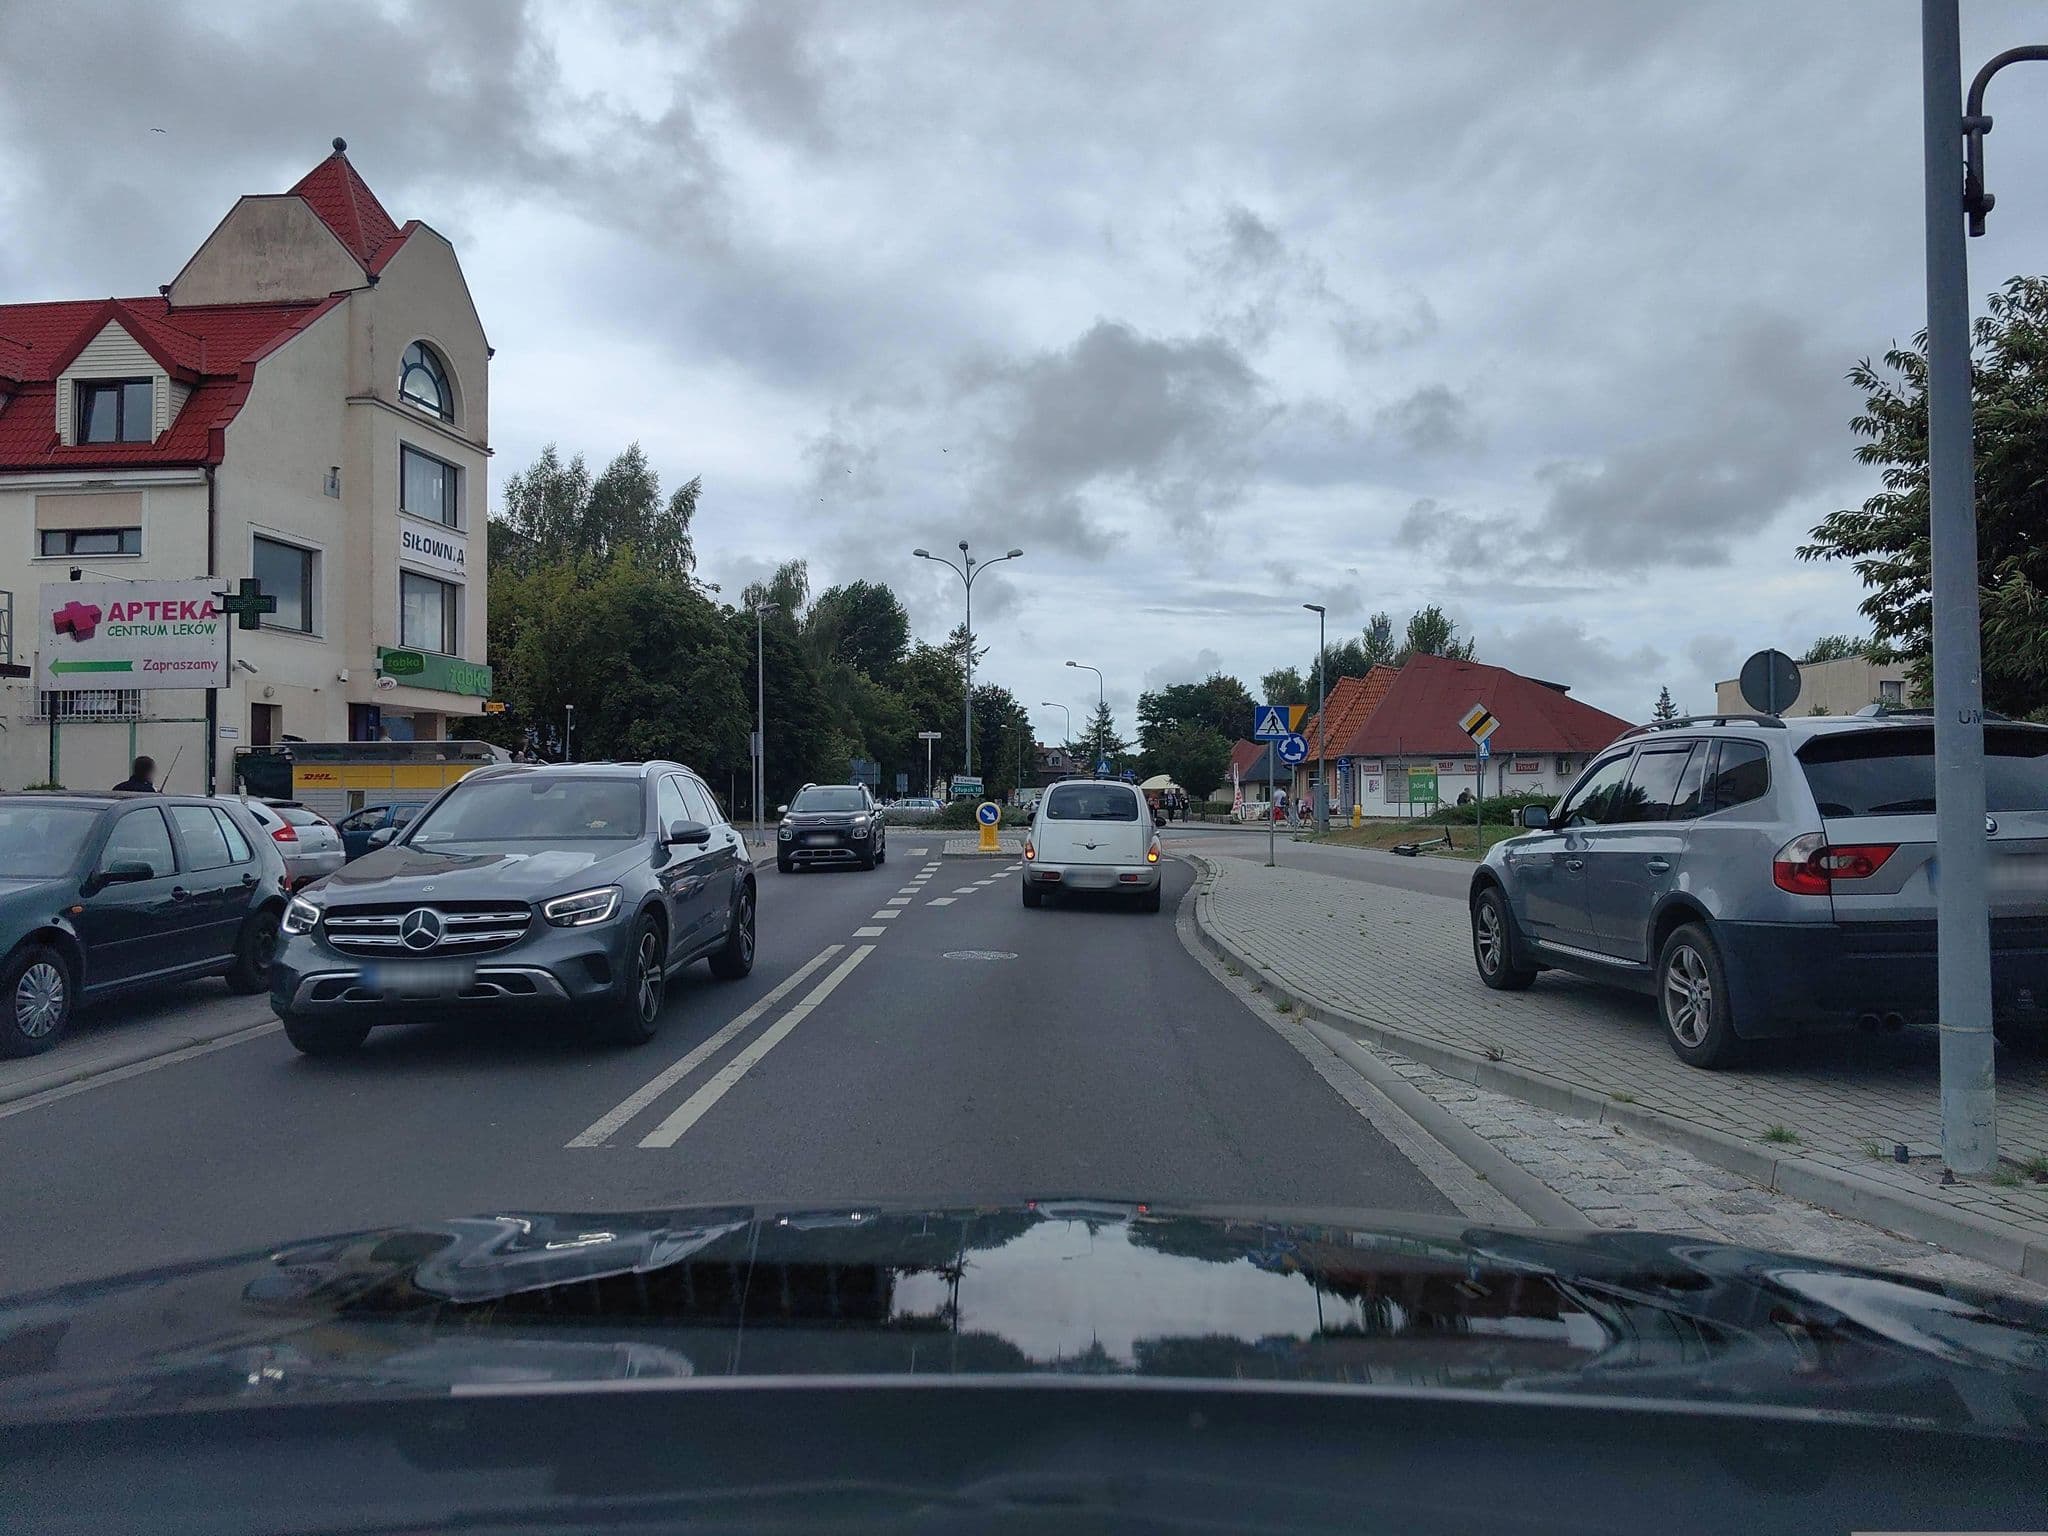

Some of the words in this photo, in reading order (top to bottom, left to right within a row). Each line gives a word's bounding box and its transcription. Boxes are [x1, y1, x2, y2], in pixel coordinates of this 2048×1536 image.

[402, 531, 465, 566] SIŁOWNA
[107, 600, 218, 622] APTEKA
[107, 625, 169, 637] CENTRUM
[173, 621, 217, 636] LEKÓW
[143, 658, 219, 674] Zapraszamy
[304, 773, 332, 781] DHL
